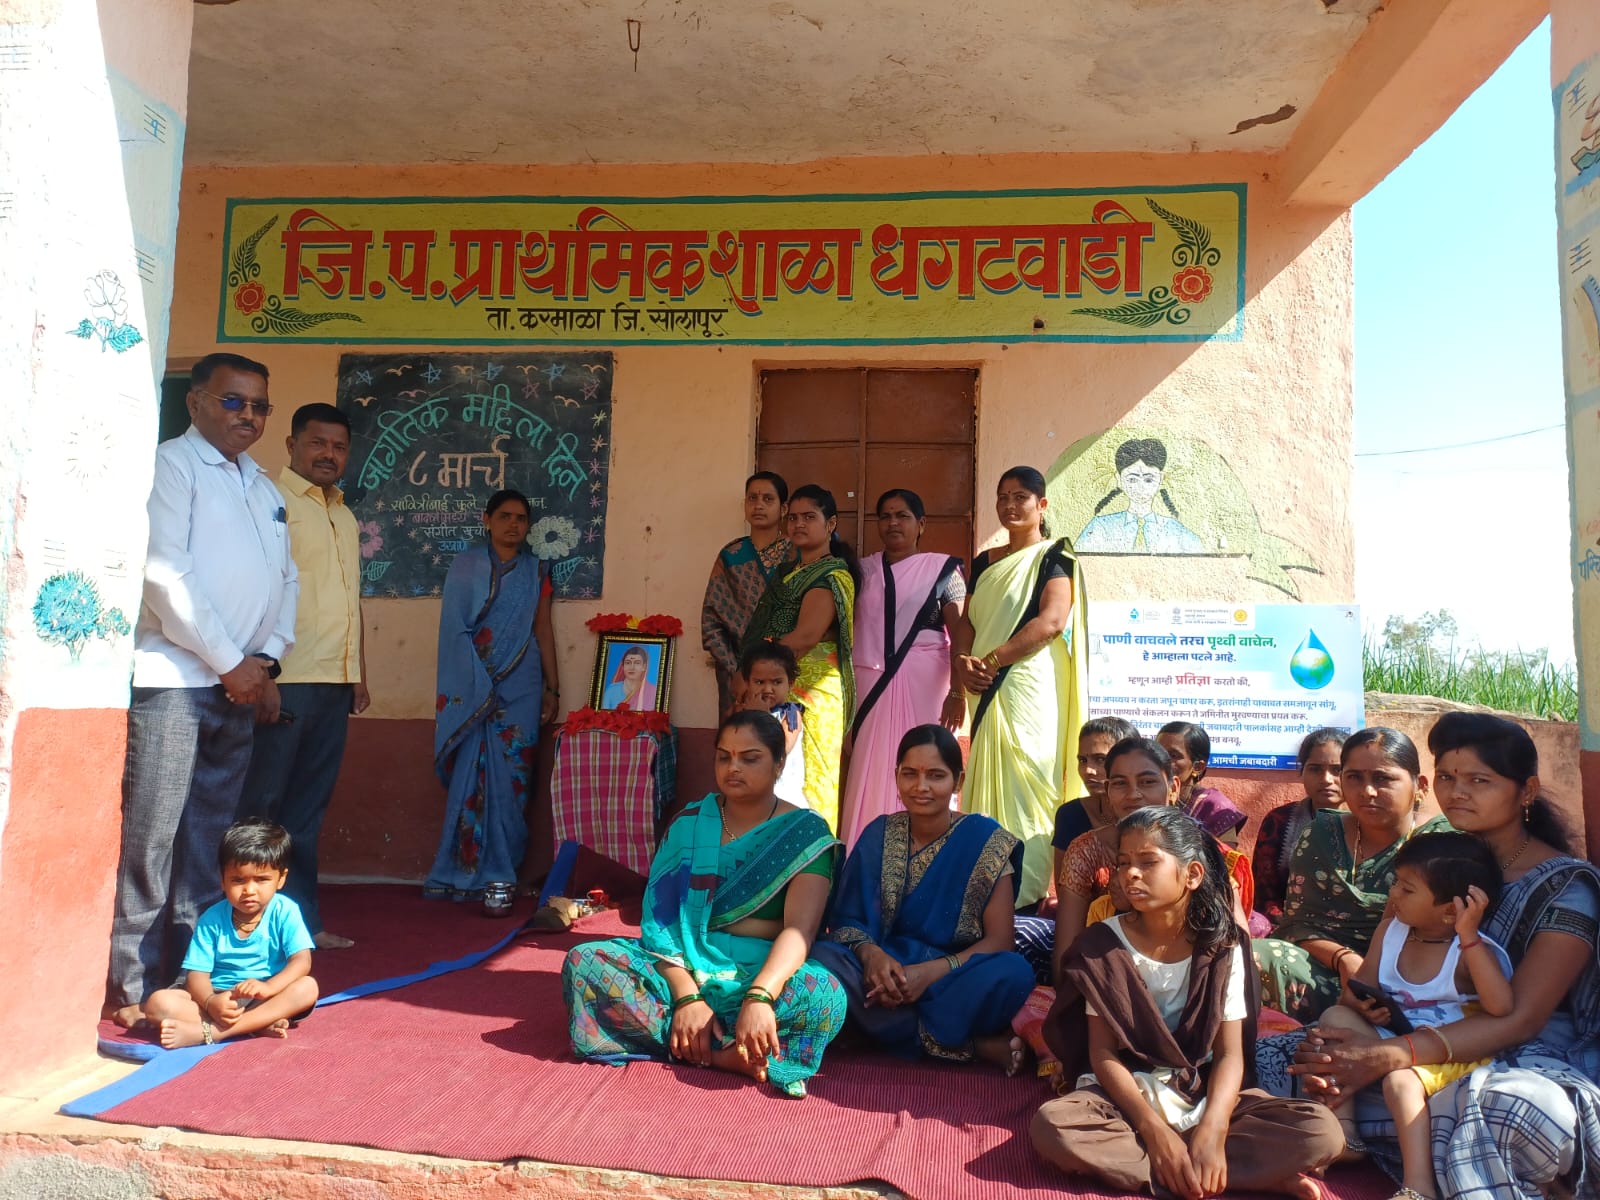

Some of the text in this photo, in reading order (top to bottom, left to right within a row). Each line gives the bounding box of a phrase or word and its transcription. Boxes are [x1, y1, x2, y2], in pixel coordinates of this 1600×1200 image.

[869, 199, 1156, 302] धगटवाडी
[357, 383, 588, 502] जागतिक महिला दिन
[408, 433, 511, 490] ८ मार्च
[420, 522, 458, 538] संगीत
[1103, 632, 1277, 650] पाणी वाचवले तरच पृथ्वी वाचेल,
[1142, 650, 1237, 663] हे आम्हाला पटले आहे.
[1128, 676, 1150, 687] म्हणून
[1152, 675, 1173, 685] आम्ही
[1175, 672, 1211, 687] प्रतिज्ञा
[1213, 676, 1235, 686] करतो
[1160, 697, 1178, 707] जपून
[1212, 754, 1278, 767] आमची जबाबदारी
